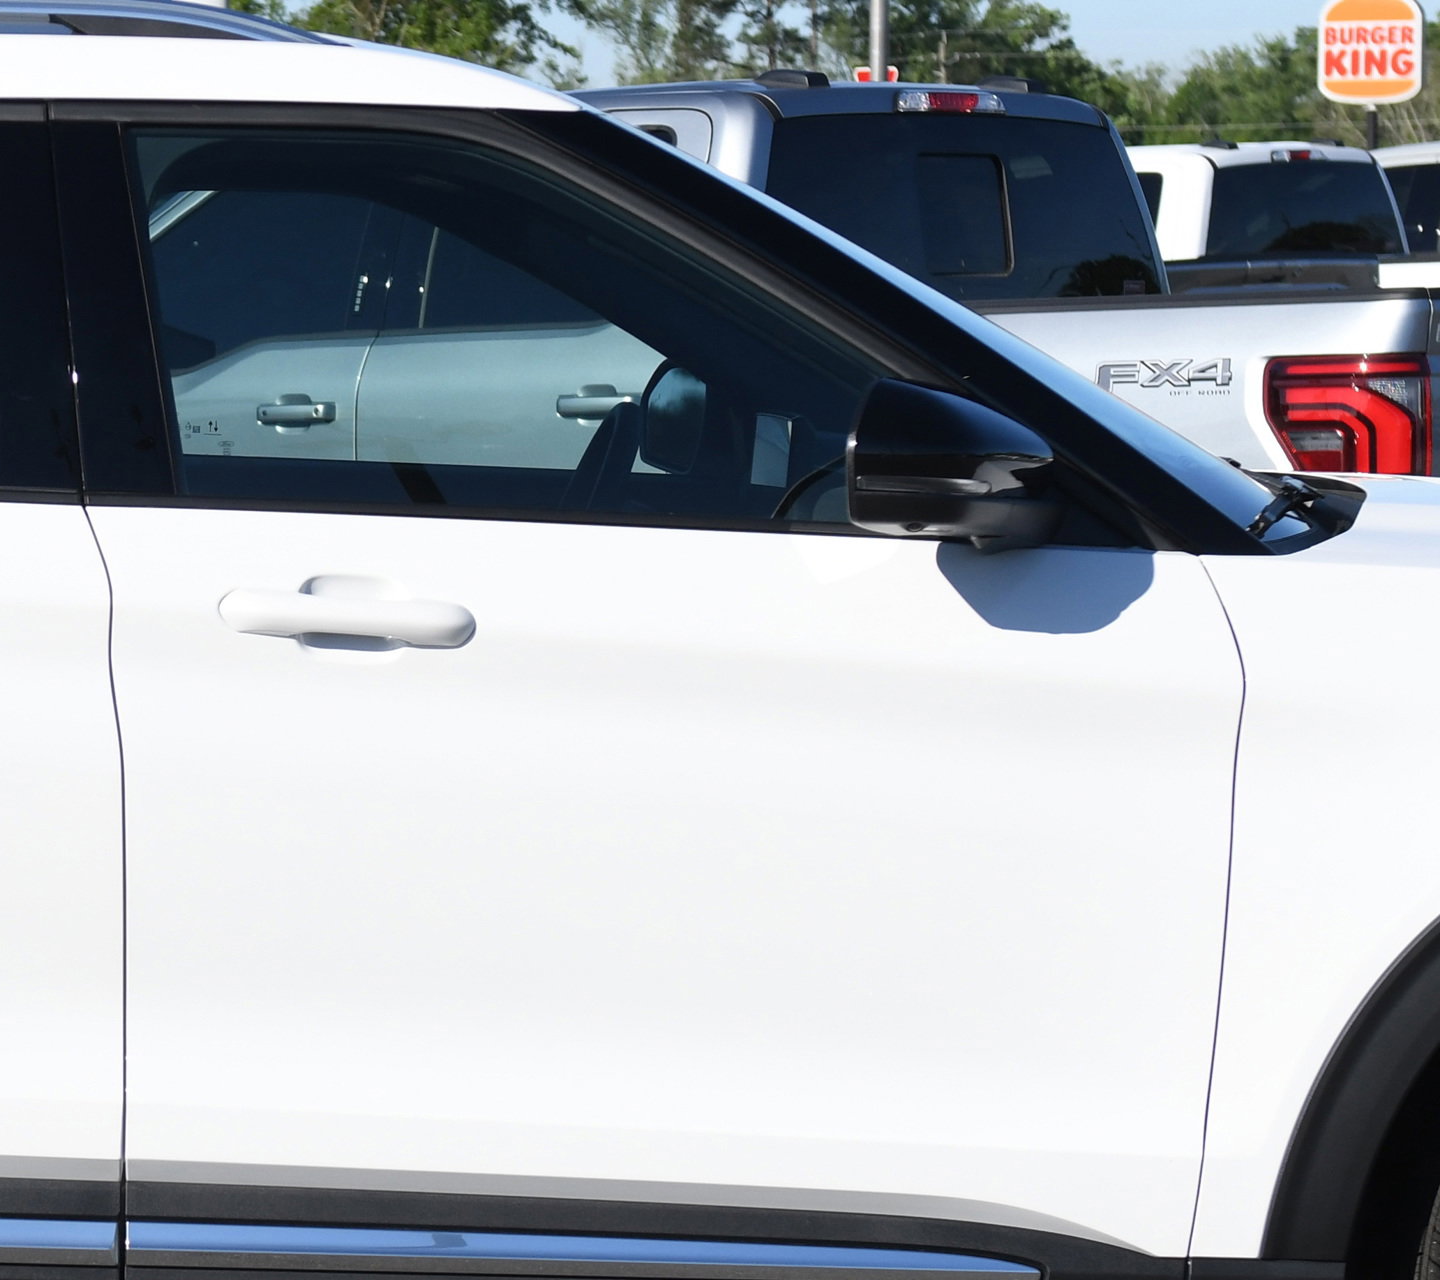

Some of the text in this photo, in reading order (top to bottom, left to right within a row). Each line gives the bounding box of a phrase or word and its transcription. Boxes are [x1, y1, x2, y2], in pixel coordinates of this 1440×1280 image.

[1324, 26, 1414, 45] BURGER
[1324, 48, 1414, 76] KING
[1094, 358, 1233, 394] FX4
